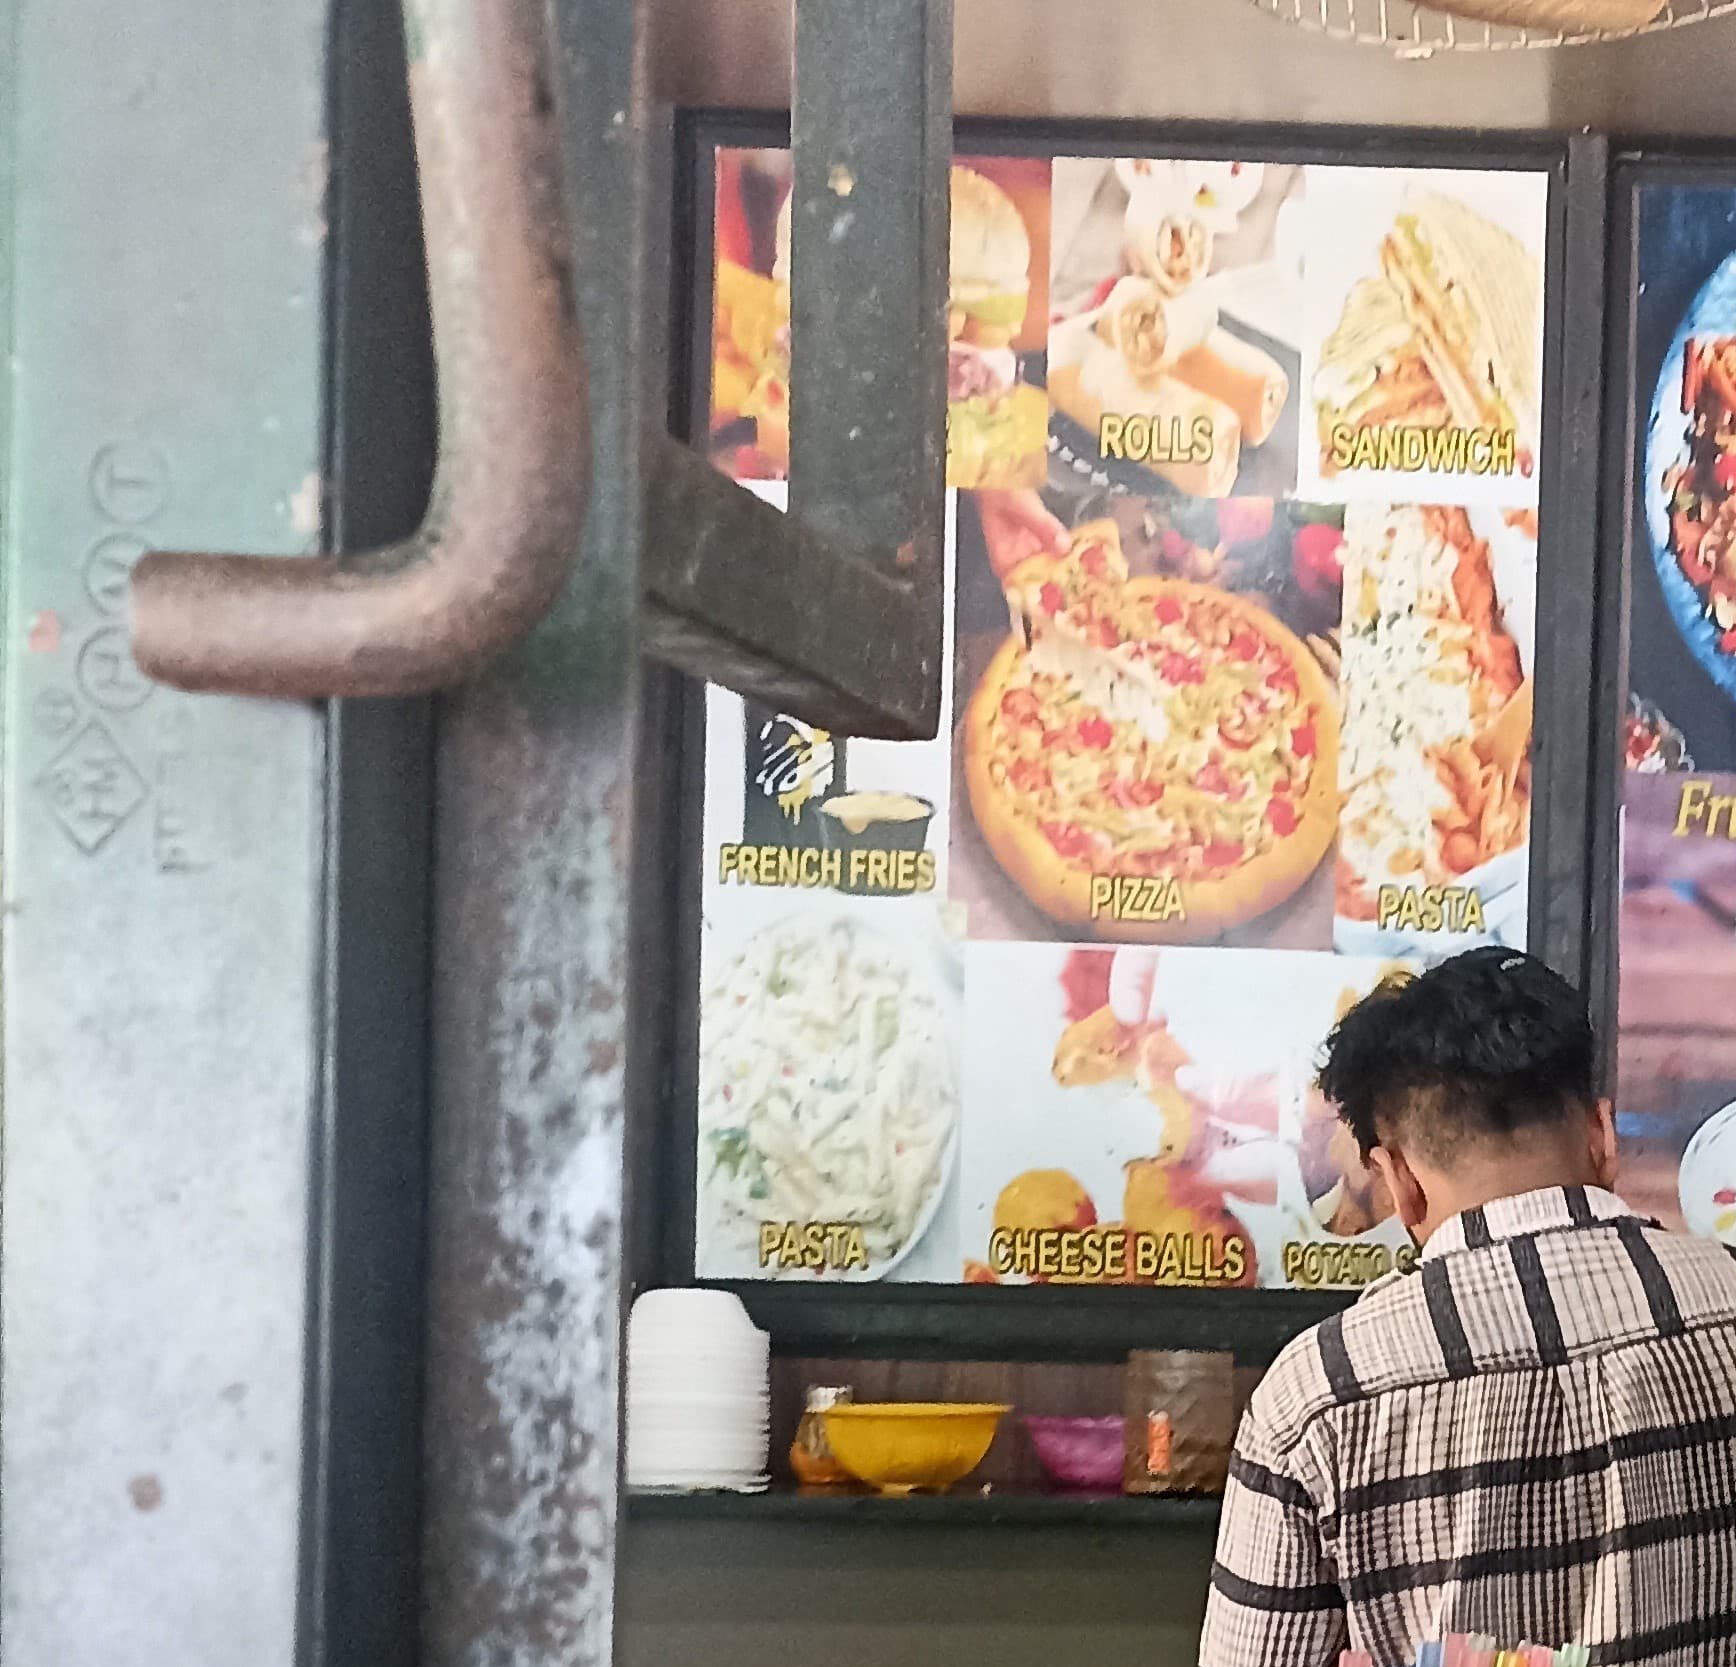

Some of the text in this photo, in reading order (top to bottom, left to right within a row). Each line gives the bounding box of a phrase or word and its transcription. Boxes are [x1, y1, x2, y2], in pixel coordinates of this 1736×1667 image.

[1099, 412, 1213, 464] ROLLS
[1332, 423, 1515, 475] SANDWICH
[719, 843, 936, 893] FRENCH FRIES
[1090, 873, 1187, 922] PIZZA
[1377, 884, 1486, 933] PASTA
[759, 1220, 869, 1271] PASTA
[989, 1227, 1246, 1281] CHEESE BALLS
[1283, 1241, 1391, 1285] POTATO
